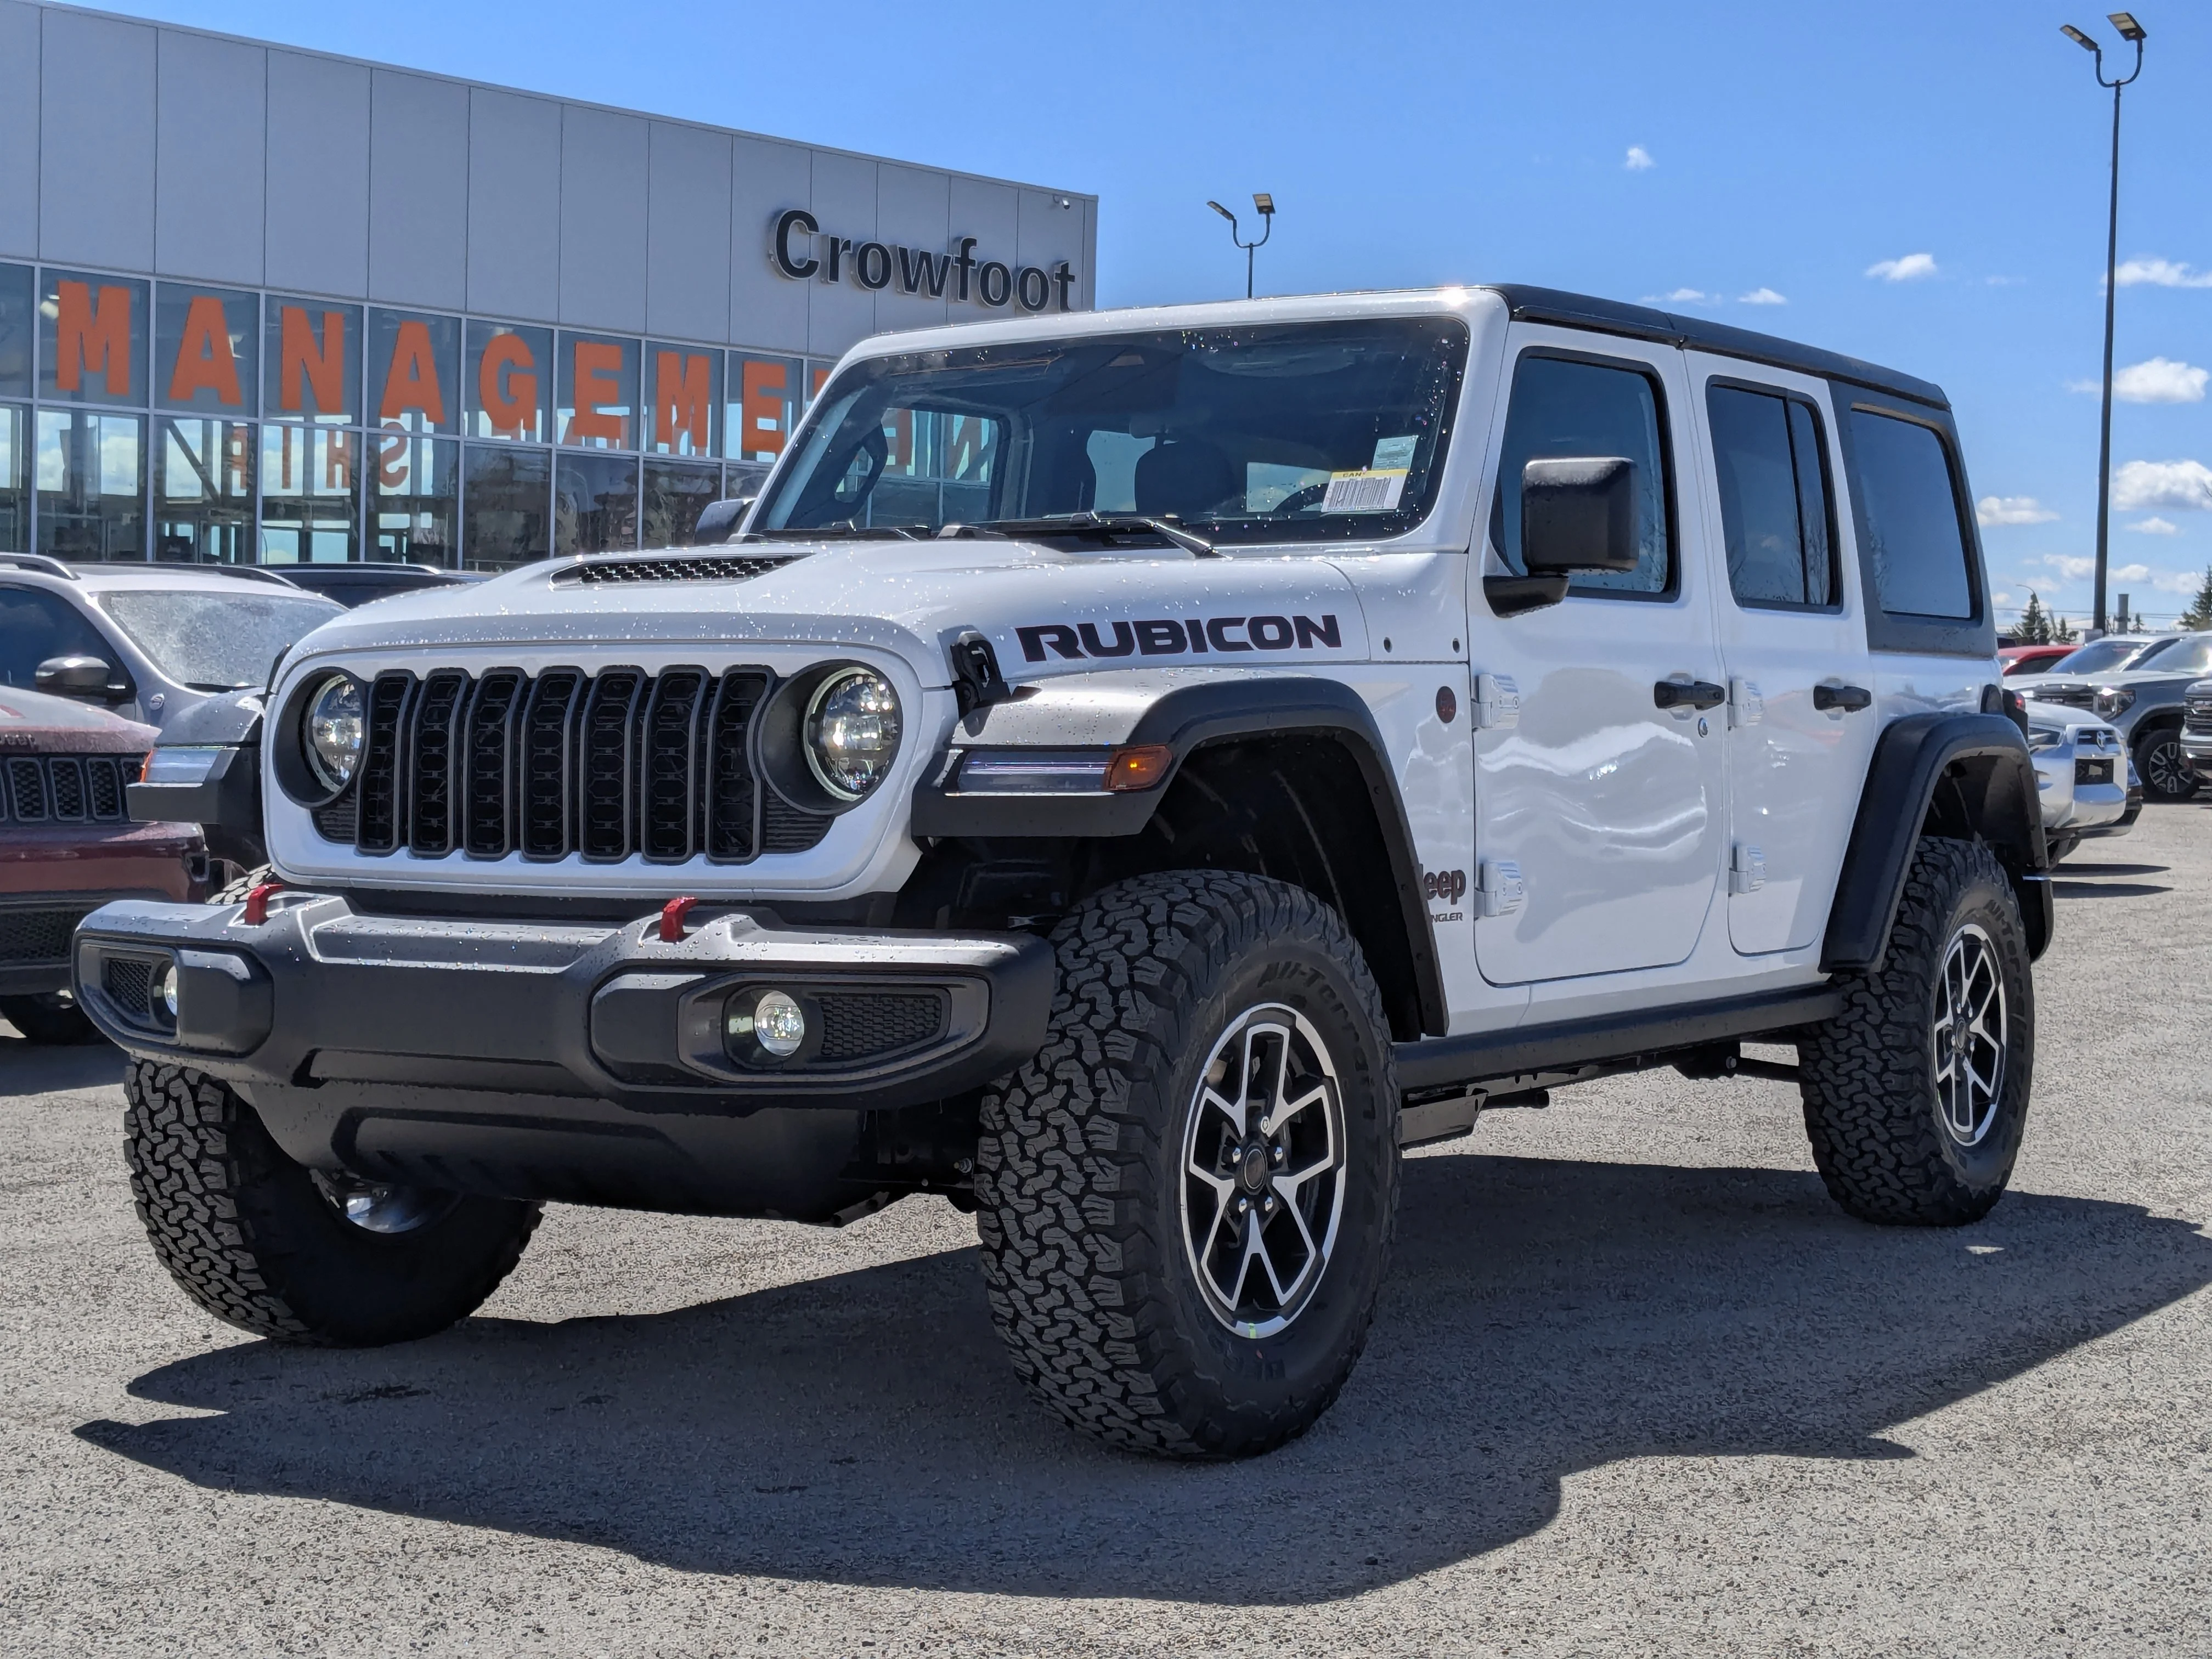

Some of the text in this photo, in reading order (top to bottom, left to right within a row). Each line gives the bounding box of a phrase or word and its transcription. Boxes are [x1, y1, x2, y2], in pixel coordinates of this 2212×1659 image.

[772, 209, 1075, 312] Crowfoot
[57, 280, 831, 454] MANAGEME
[1015, 614, 1341, 662] RUBICON
[1419, 864, 1466, 905] eep
